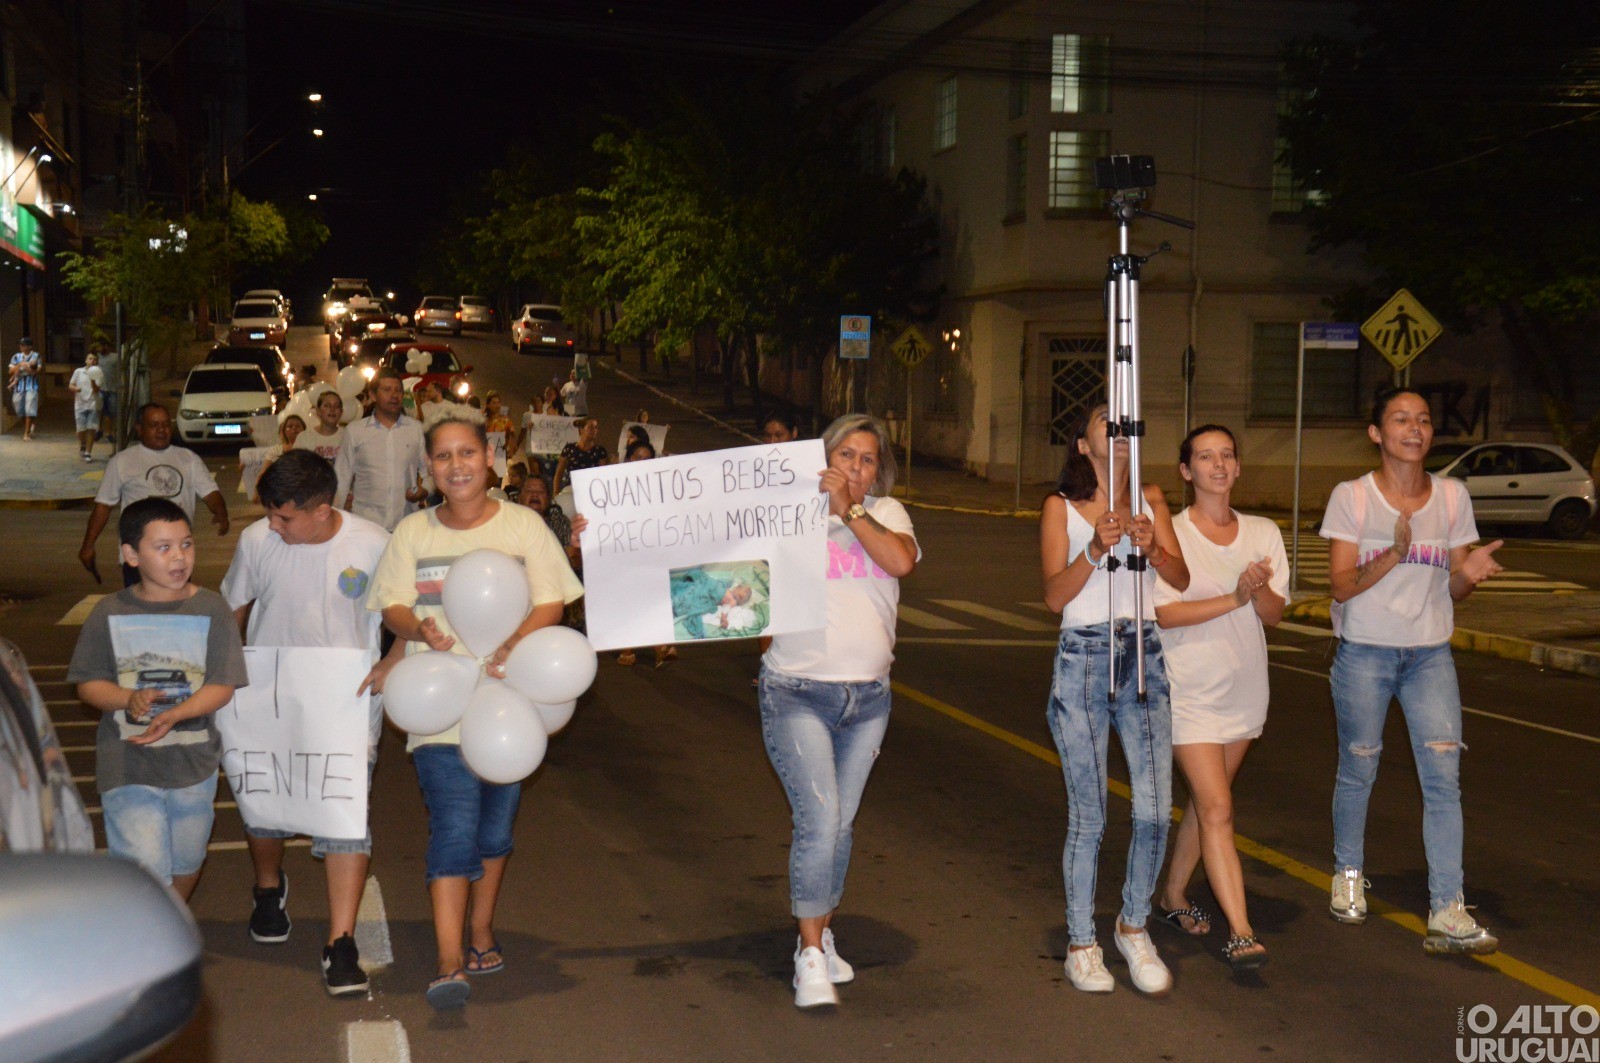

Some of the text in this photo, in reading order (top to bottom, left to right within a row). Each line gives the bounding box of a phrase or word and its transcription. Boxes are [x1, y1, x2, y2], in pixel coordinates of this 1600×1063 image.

[588, 447, 796, 515] QUANTOS BEBÊS
[597, 512, 715, 557] PRECISAM
[223, 747, 354, 800] GENTE
